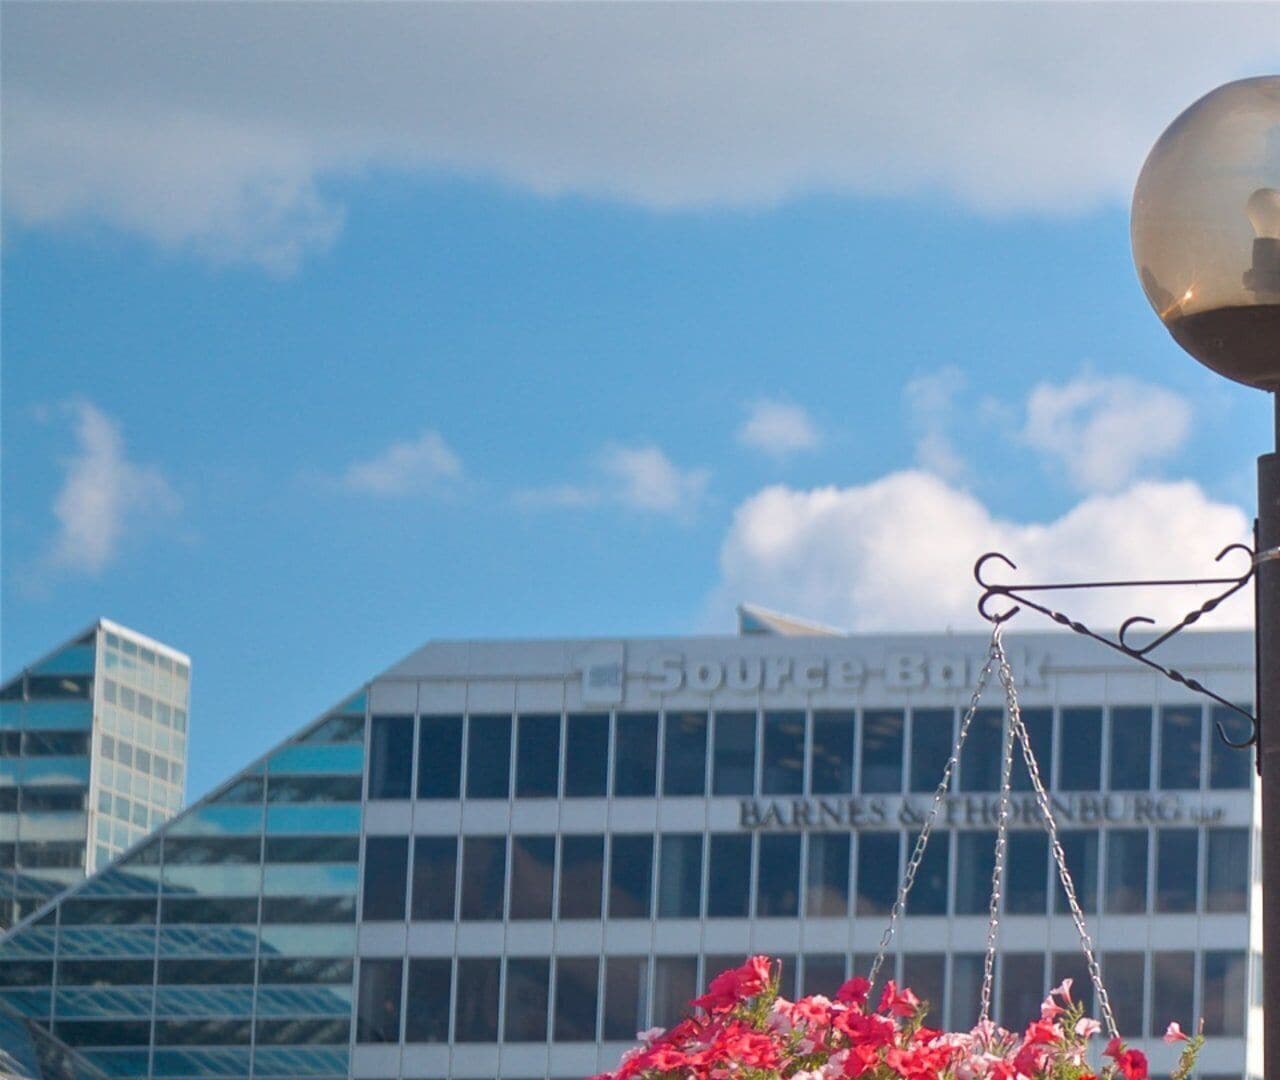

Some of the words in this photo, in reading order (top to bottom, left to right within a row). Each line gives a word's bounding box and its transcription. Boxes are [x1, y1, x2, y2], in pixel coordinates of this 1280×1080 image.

[648, 652, 866, 692] Source
[885, 651, 1053, 690] Bank
[739, 800, 887, 829] BARNES
[898, 799, 927, 826] &
[941, 796, 1184, 826] THORNBURG
